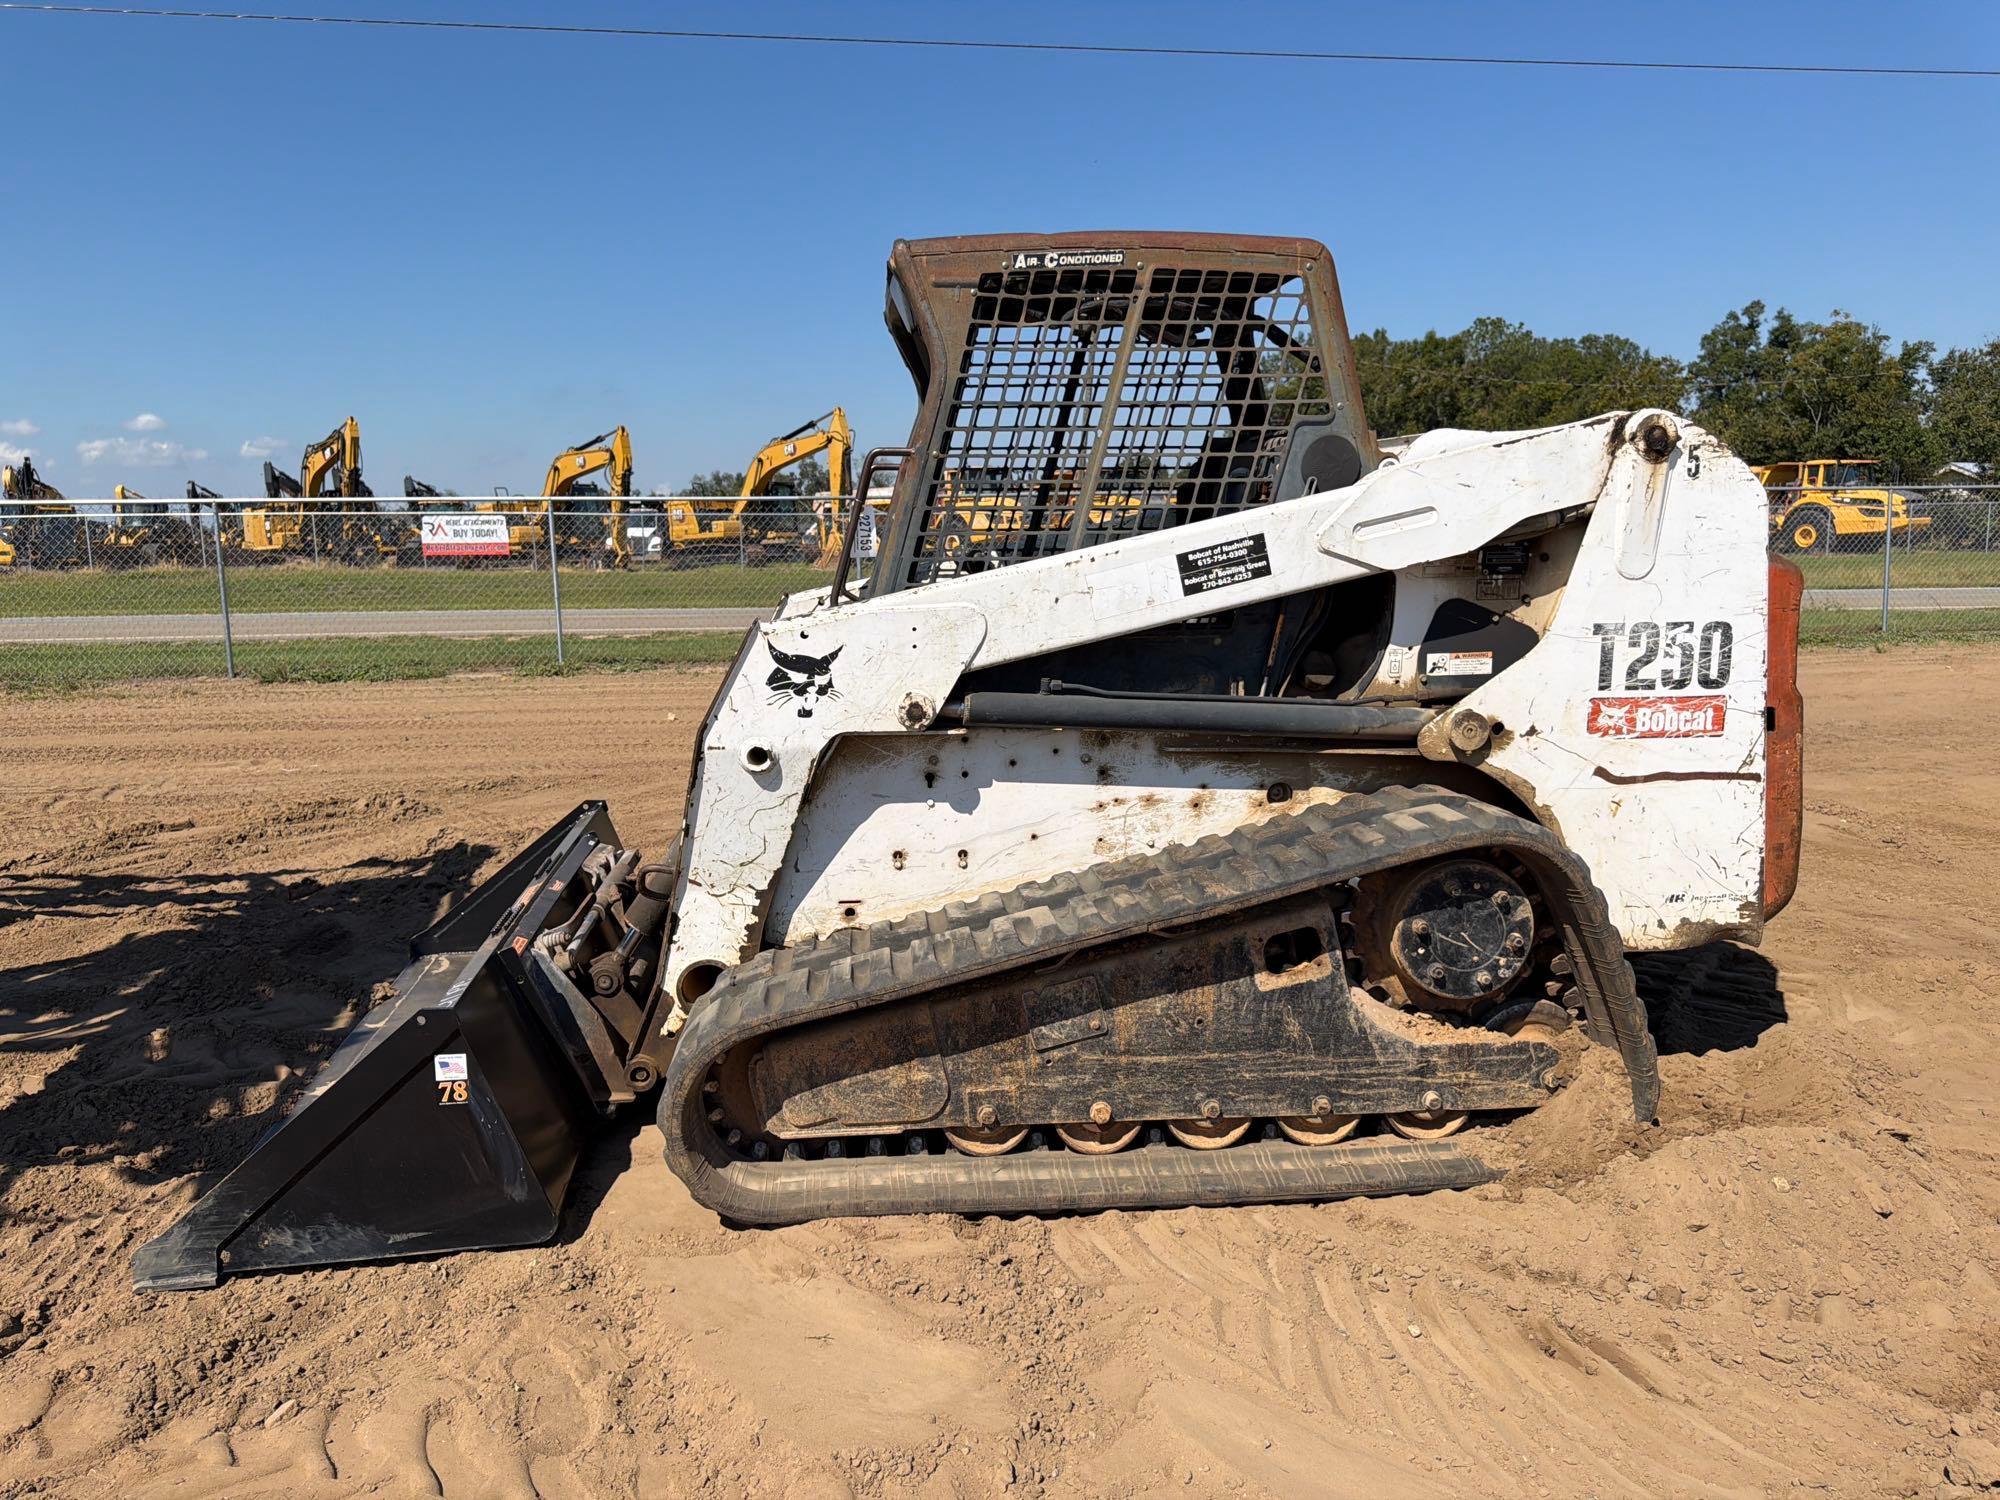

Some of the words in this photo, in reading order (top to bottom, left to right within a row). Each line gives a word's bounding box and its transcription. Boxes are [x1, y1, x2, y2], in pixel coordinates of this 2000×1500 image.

[1044, 252, 1123, 268] CONDITIONED
[1687, 444, 1701, 478] 5
[453, 529, 468, 538] BUY
[470, 529, 498, 538] TODAY!
[1188, 550, 1212, 561] Bobcat
[1213, 547, 1221, 555] of
[1222, 539, 1254, 552] Nashville
[1197, 548, 1248, 567] 615-754-0300
[1184, 575, 1208, 586] Bobcat
[1209, 570, 1217, 579] of
[1217, 565, 1246, 577] Bowling
[1246, 560, 1267, 570] Green
[1201, 571, 1252, 590] 270-842-4253
[1592, 621, 1734, 691] T250
[1635, 704, 1715, 733] Bobcat
[438, 1081, 468, 1103] 78
